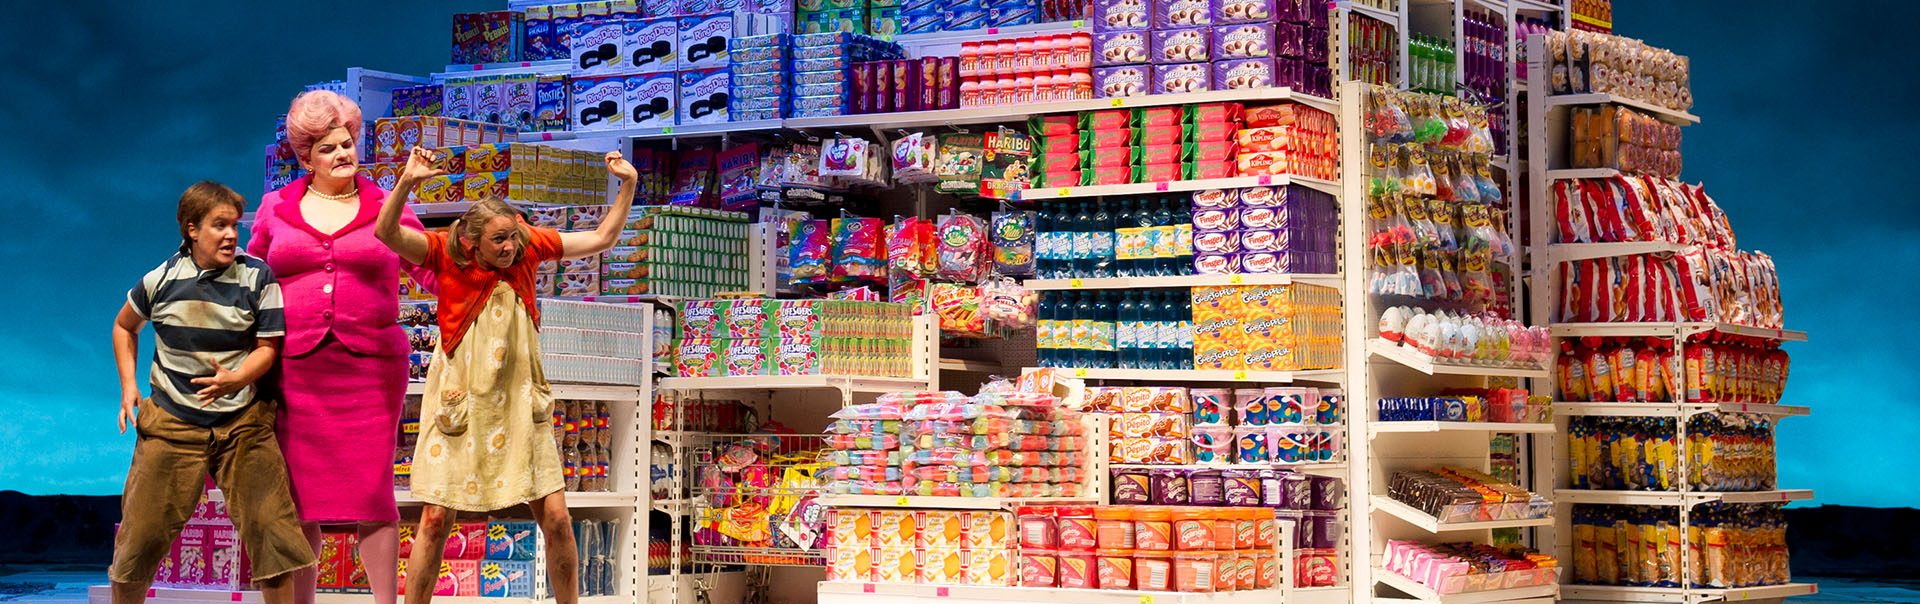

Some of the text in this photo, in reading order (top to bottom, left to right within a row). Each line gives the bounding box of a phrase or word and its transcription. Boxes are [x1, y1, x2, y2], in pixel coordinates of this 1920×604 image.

[538, 86, 566, 105] FROSTIES
[546, 119, 564, 127] WIN
[988, 135, 1031, 151] HARIBO
